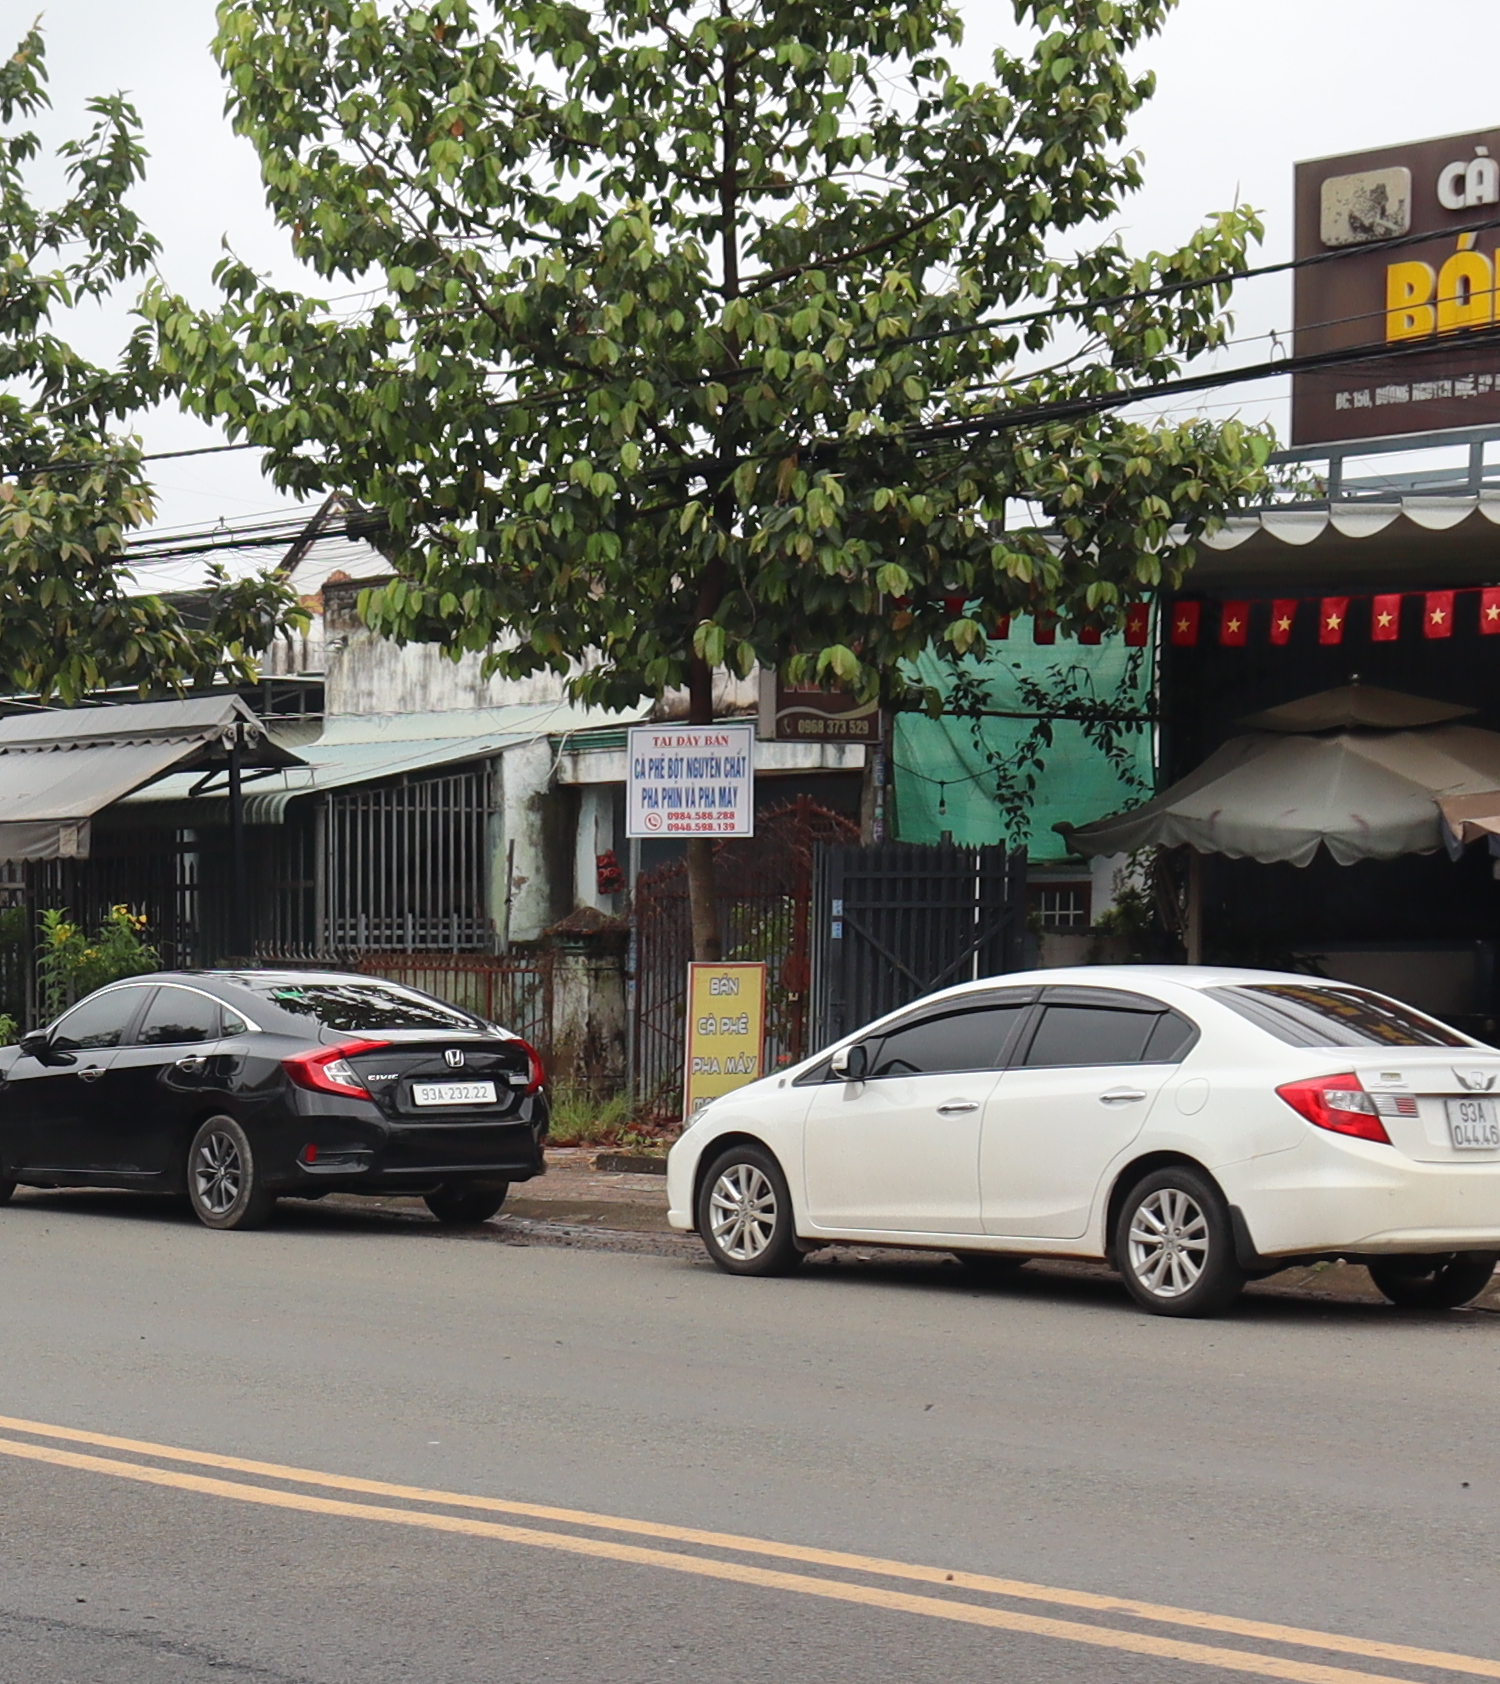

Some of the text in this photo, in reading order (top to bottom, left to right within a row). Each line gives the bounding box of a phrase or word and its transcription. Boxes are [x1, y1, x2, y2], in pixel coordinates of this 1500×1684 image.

[1436, 146, 1499, 210] CÀ
[798, 719, 869, 734] 0968 373 529
[704, 732, 729, 746] BÁN
[634, 748, 746, 784] CÀ PHÊ BỘT NGUYÊN CHẤT
[641, 781, 739, 809] PHA PHIN VÀ PHA MÁY
[709, 973, 740, 996] BÁN
[697, 1012, 748, 1035] CÀ PHÊ
[691, 1052, 757, 1075] PHA MÁY
[367, 1073, 400, 1081] CIVIC
[421, 1086, 489, 1101] 93A-232.22
[1459, 1102, 1487, 1123] 93A
[1453, 1125, 1499, 1146] 044.46
